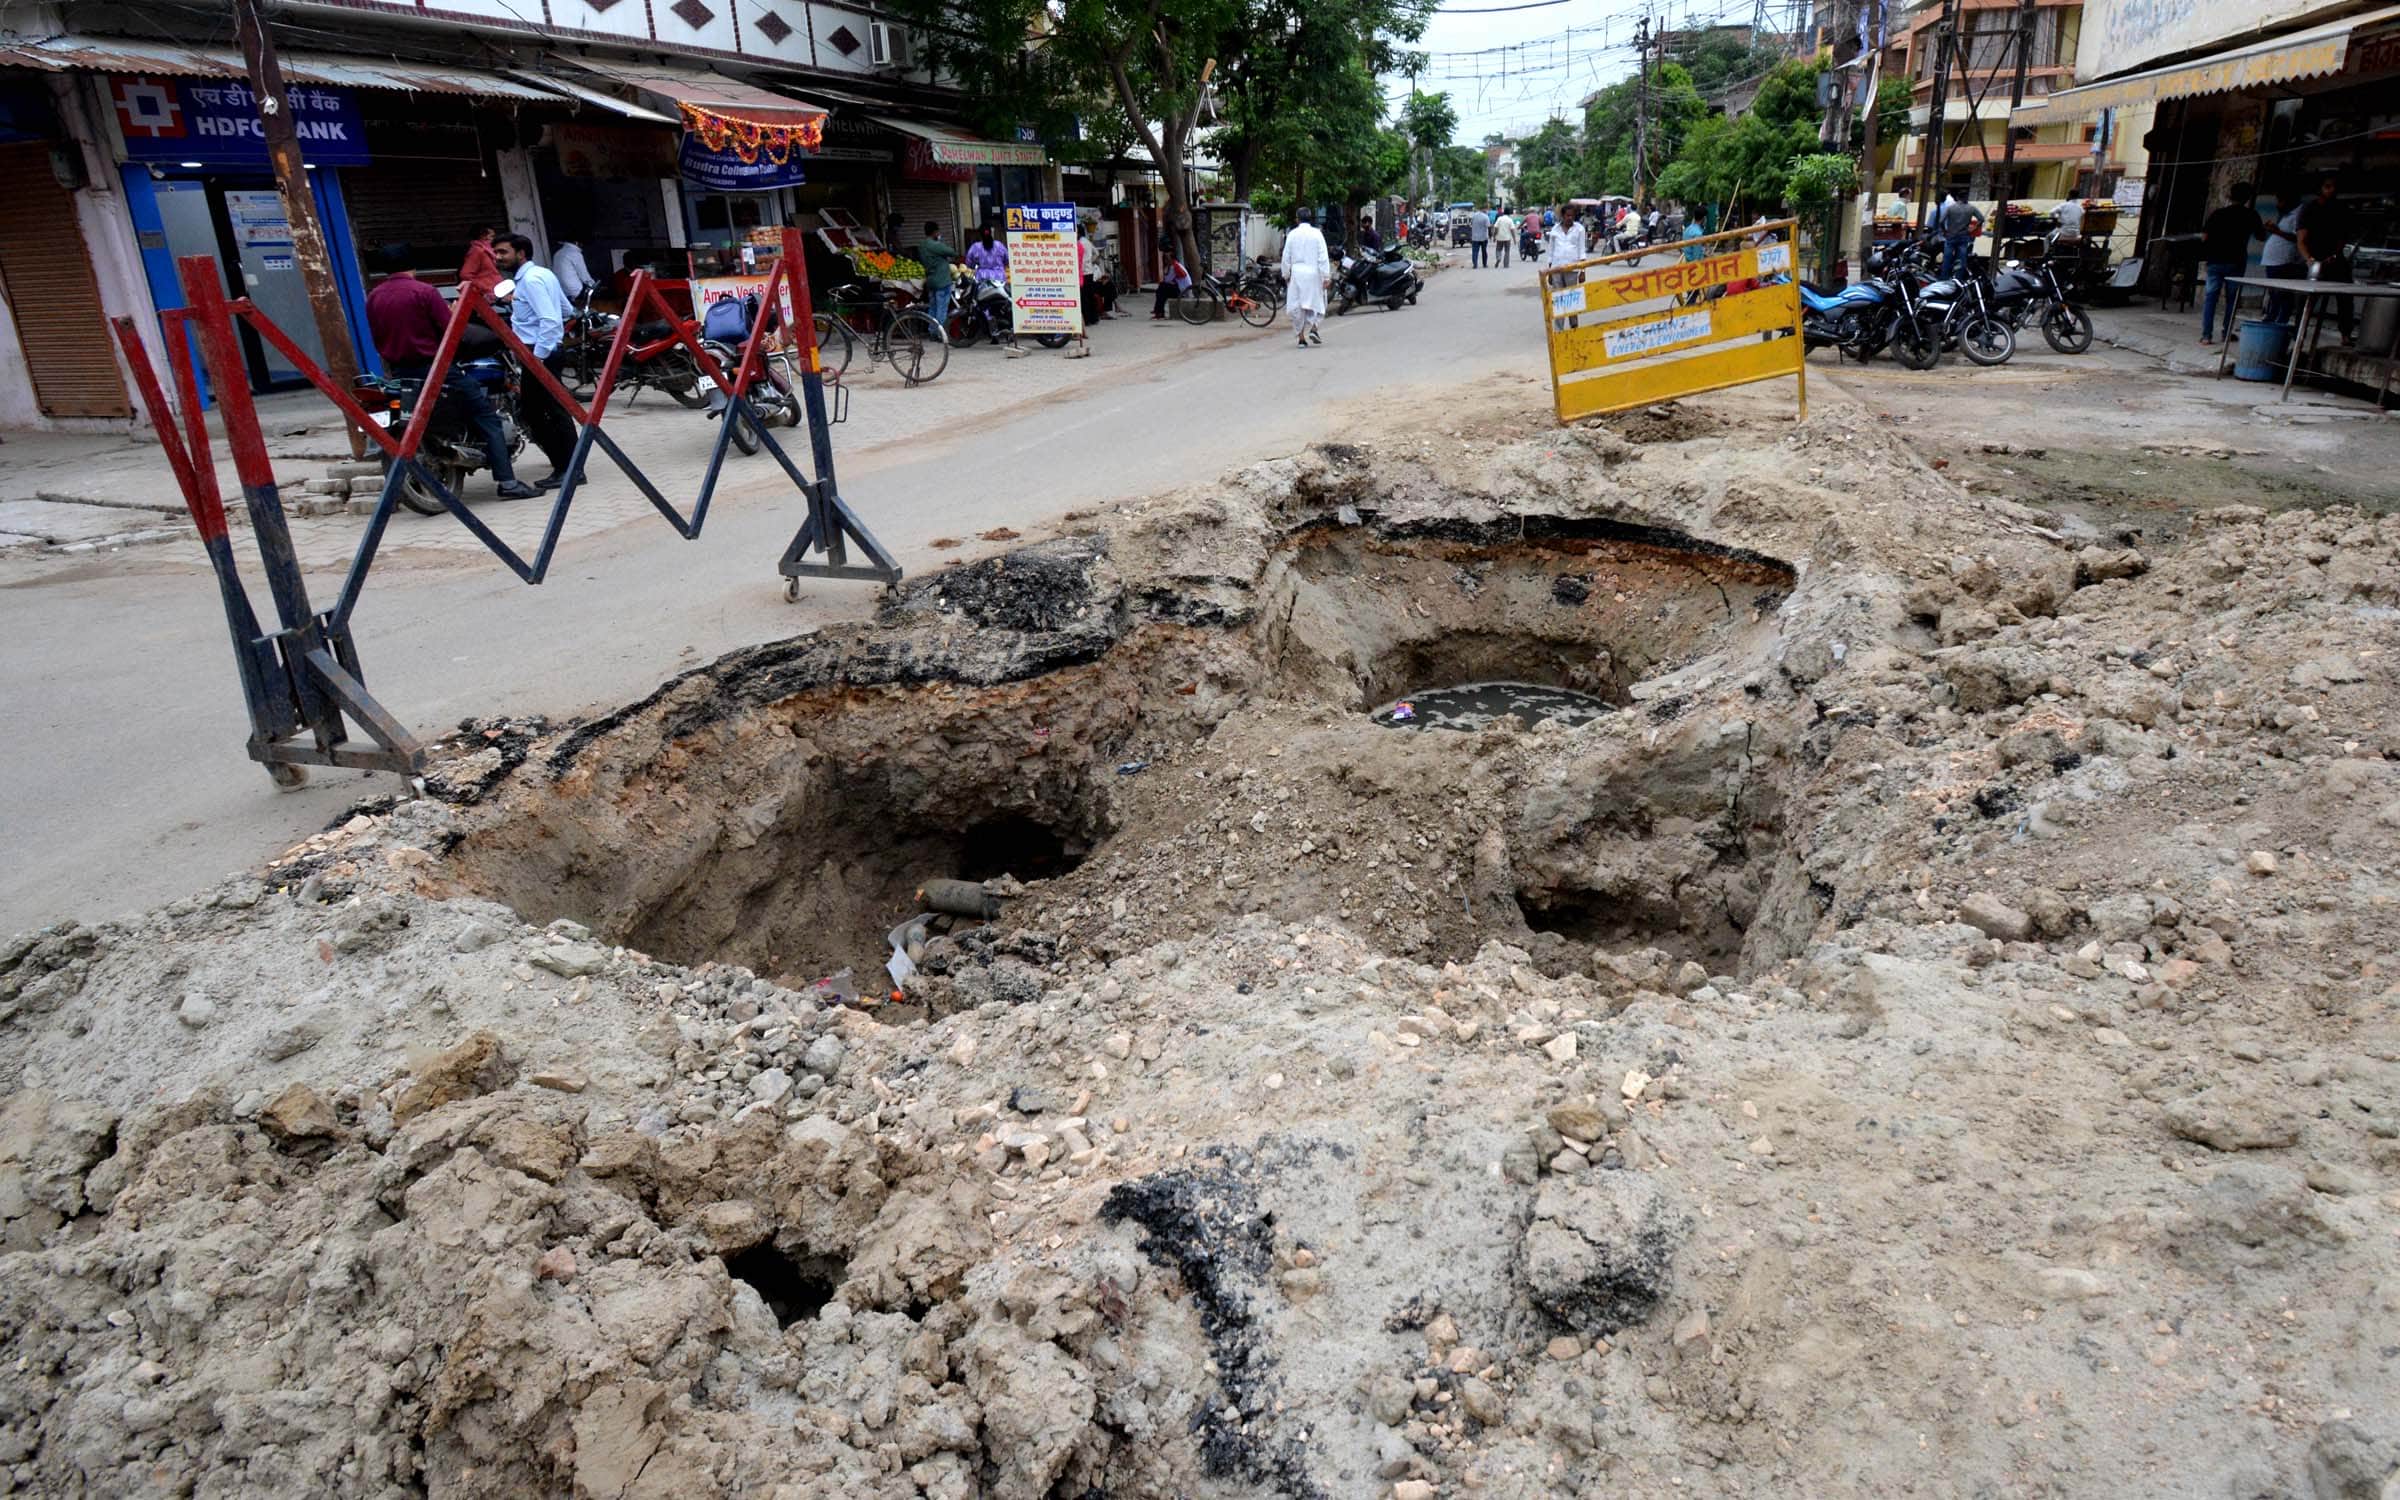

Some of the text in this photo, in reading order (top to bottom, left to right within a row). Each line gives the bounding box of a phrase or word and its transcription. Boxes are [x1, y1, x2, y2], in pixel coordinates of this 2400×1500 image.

[190, 87, 221, 107] एच
[224, 83, 247, 107] डी
[311, 88, 341, 112] बैंक
[196, 116, 265, 138] HDFC
[296, 120, 348, 141] ANK
[1609, 254, 1742, 303] सावधान
